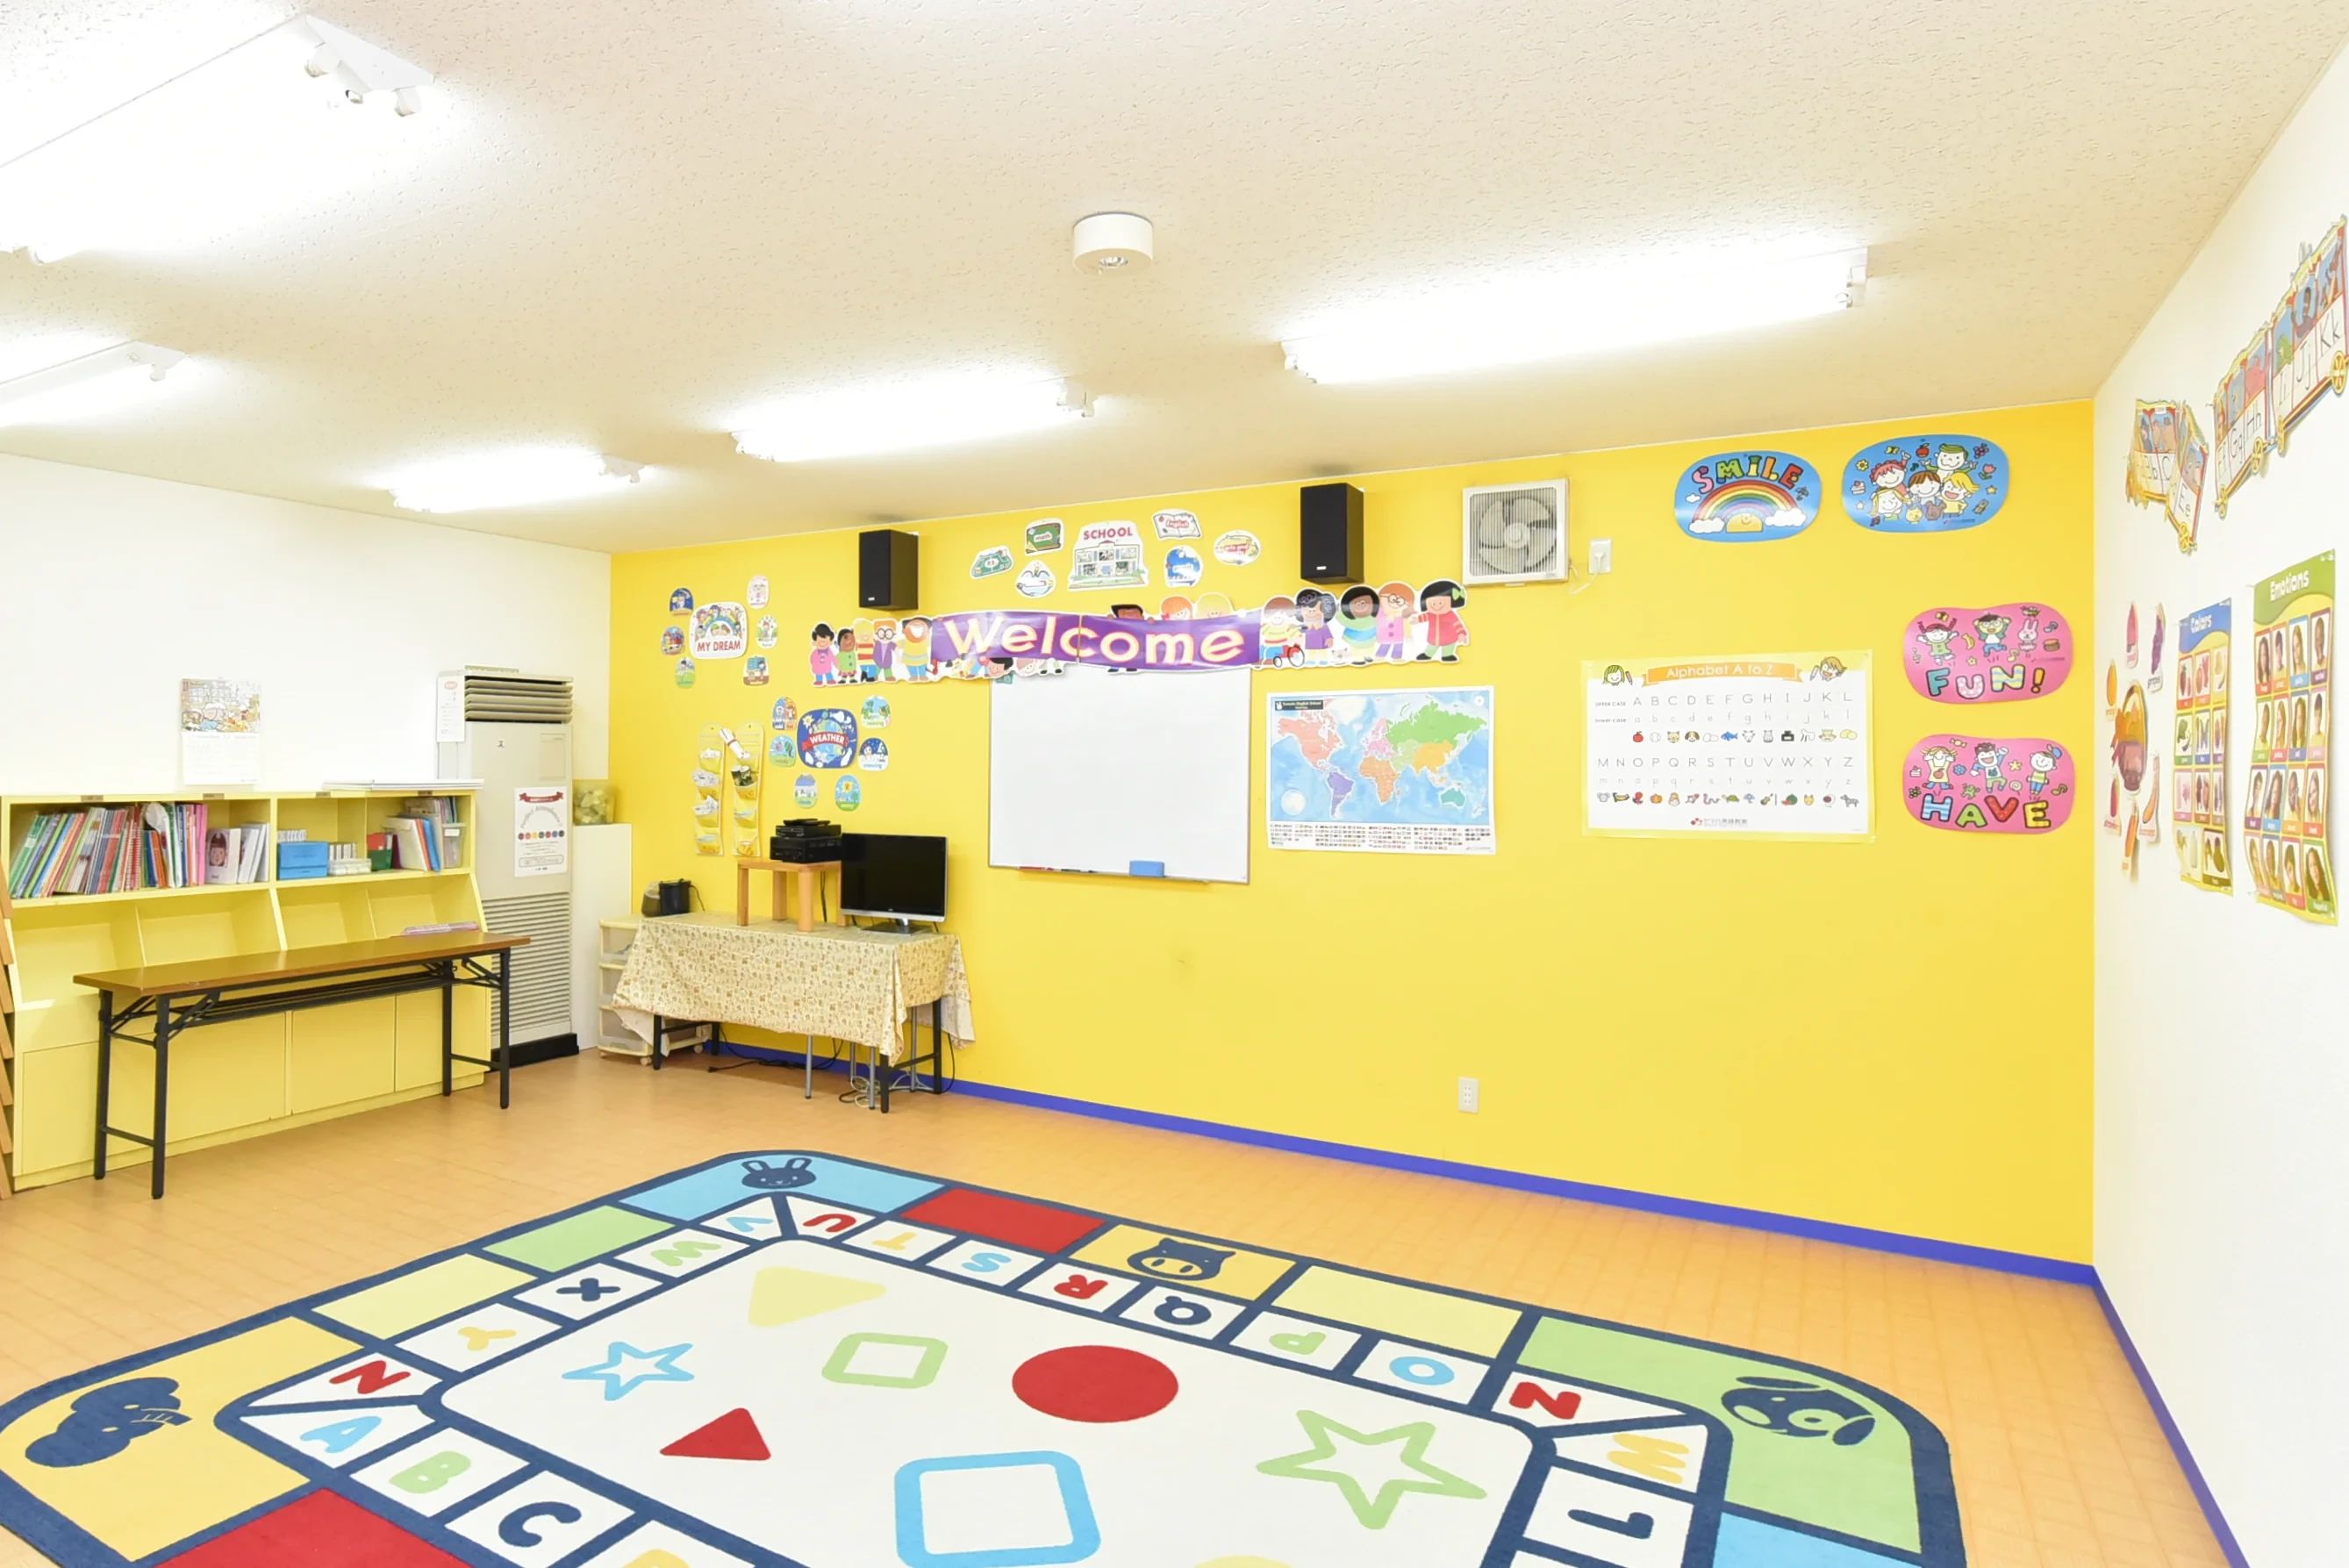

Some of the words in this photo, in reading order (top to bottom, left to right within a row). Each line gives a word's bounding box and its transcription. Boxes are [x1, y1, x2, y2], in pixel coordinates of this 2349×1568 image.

[1691, 454, 1803, 495] SMILE
[1083, 526, 1134, 541] SCHOOL
[2269, 569, 2310, 601] Emotions
[2190, 612, 2213, 634] Colors
[697, 641, 712, 653] MY
[713, 640, 741, 652] DREAM
[944, 616, 1245, 667] Welcome
[1666, 665, 1729, 679] Alphabet
[1732, 664, 1744, 675] A
[1748, 664, 1761, 676] to
[1765, 664, 1775, 676] Z
[1925, 664, 2046, 700] FUN!
[1633, 697, 1642, 705] A
[1651, 696, 1659, 705] B
[1668, 696, 1678, 705] C
[1687, 695, 1695, 705] D
[1706, 695, 1713, 705] E
[1726, 695, 1732, 704] F
[1743, 694, 1753, 703] G
[1803, 692, 1810, 702] J
[1823, 692, 1831, 701] K
[1844, 692, 1851, 701] L
[809, 734, 845, 745] WEATHER
[1598, 758, 1608, 767] M
[1633, 758, 1643, 767] O
[1669, 758, 1679, 767] Q
[1689, 758, 1696, 767] R
[1708, 758, 1715, 767] S
[1725, 758, 1735, 767] T
[1744, 758, 1753, 767] U
[1764, 758, 1772, 767] V
[1781, 758, 1795, 767] W
[1825, 758, 1831, 767] Y
[1844, 757, 1853, 767] Z
[1920, 793, 2052, 829] HAVE
[727, 1217, 773, 1232] V
[802, 1214, 856, 1233] U
[874, 1233, 914, 1249] T
[962, 1253, 1011, 1271] S
[555, 1278, 621, 1302] X
[1054, 1274, 1108, 1300] R
[1154, 1295, 1212, 1326] Q
[459, 1328, 515, 1350] Y
[1270, 1333, 1326, 1355] P
[329, 1360, 412, 1394] Z
[1390, 1357, 1454, 1385] O
[1508, 1381, 1582, 1420] N
[301, 1416, 381, 1453] A
[393, 1452, 469, 1493] B
[498, 1501, 582, 1548] C
